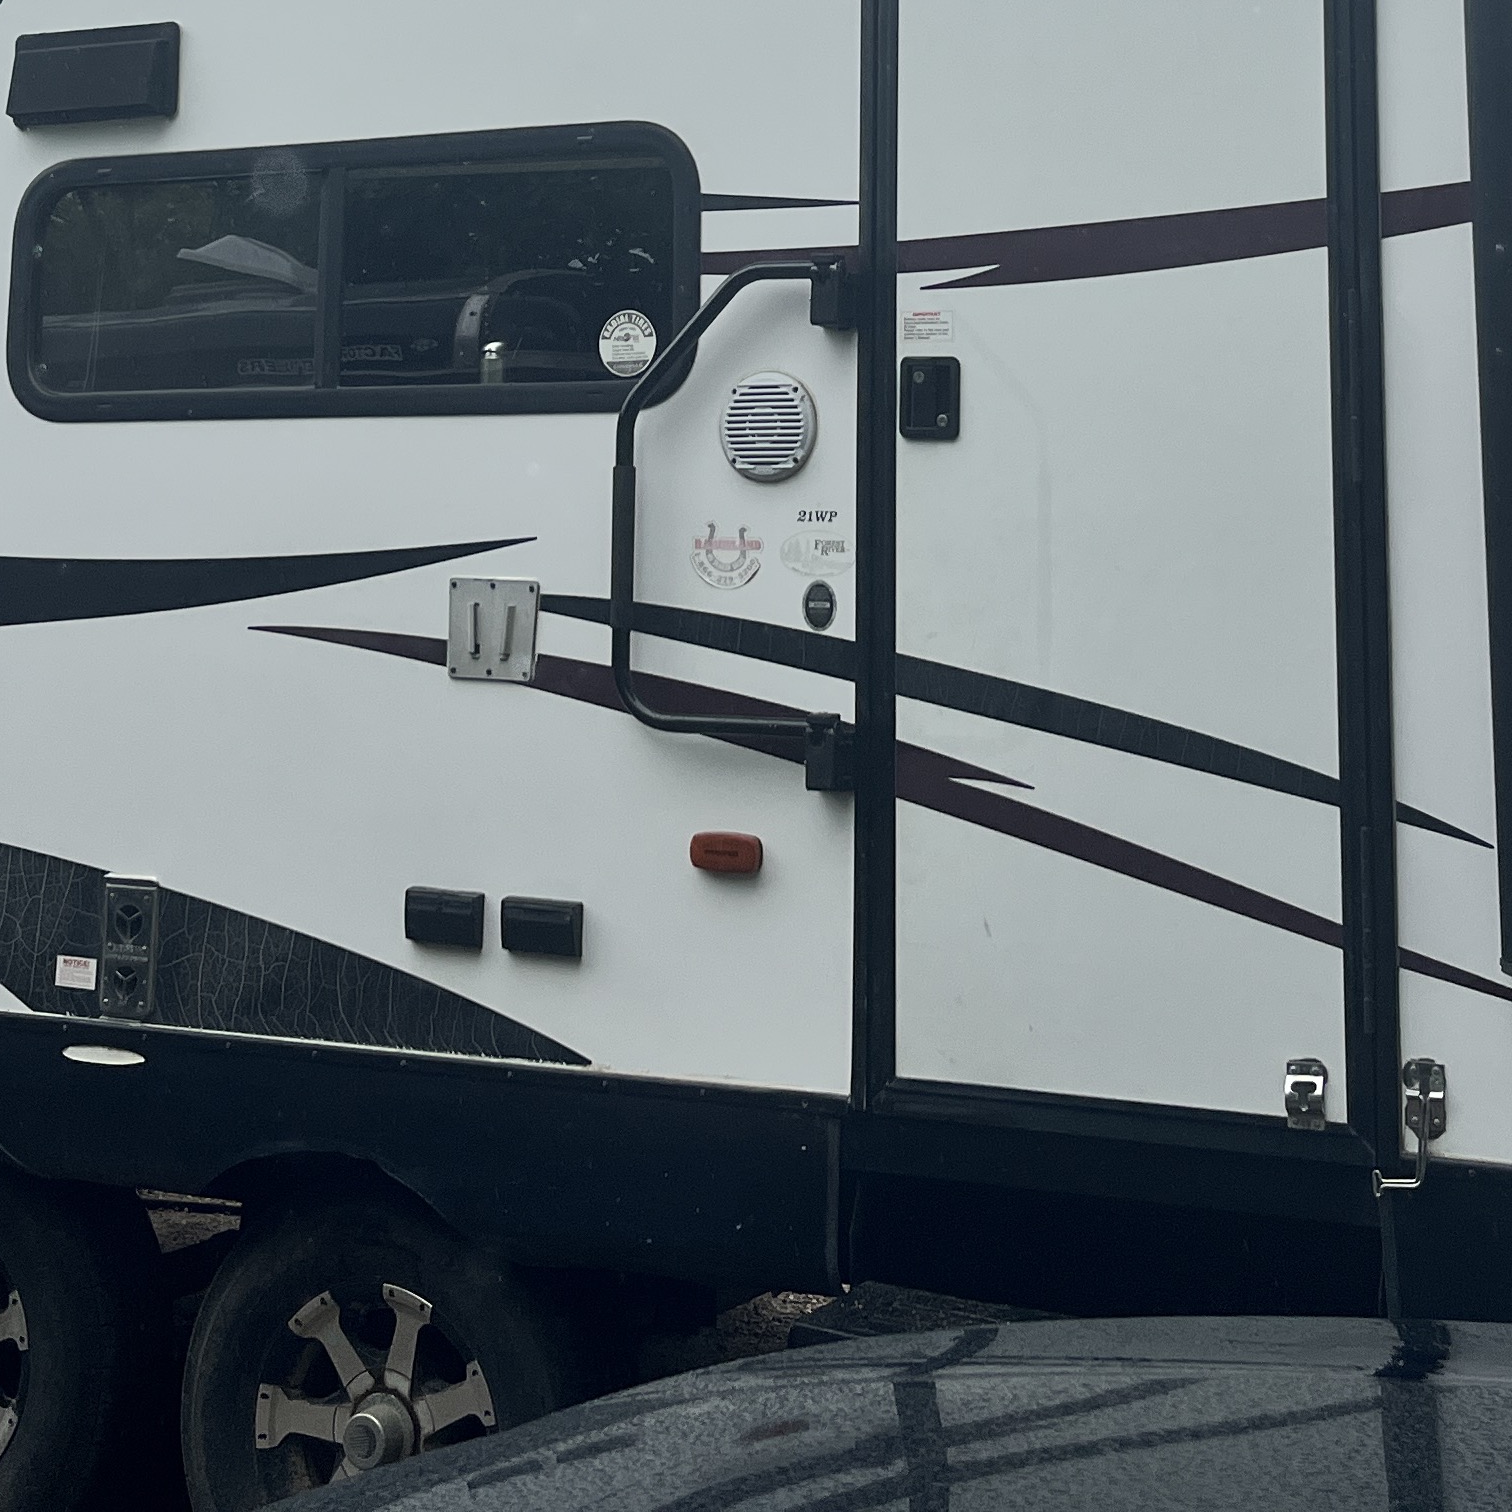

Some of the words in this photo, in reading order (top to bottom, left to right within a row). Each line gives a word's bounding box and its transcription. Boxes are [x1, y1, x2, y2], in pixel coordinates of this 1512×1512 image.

[603, 313, 629, 338] RADIAL
[631, 314, 652, 336] TIRES
[796, 509, 838, 523] 21WP
[820, 545, 846, 556] RIVER
